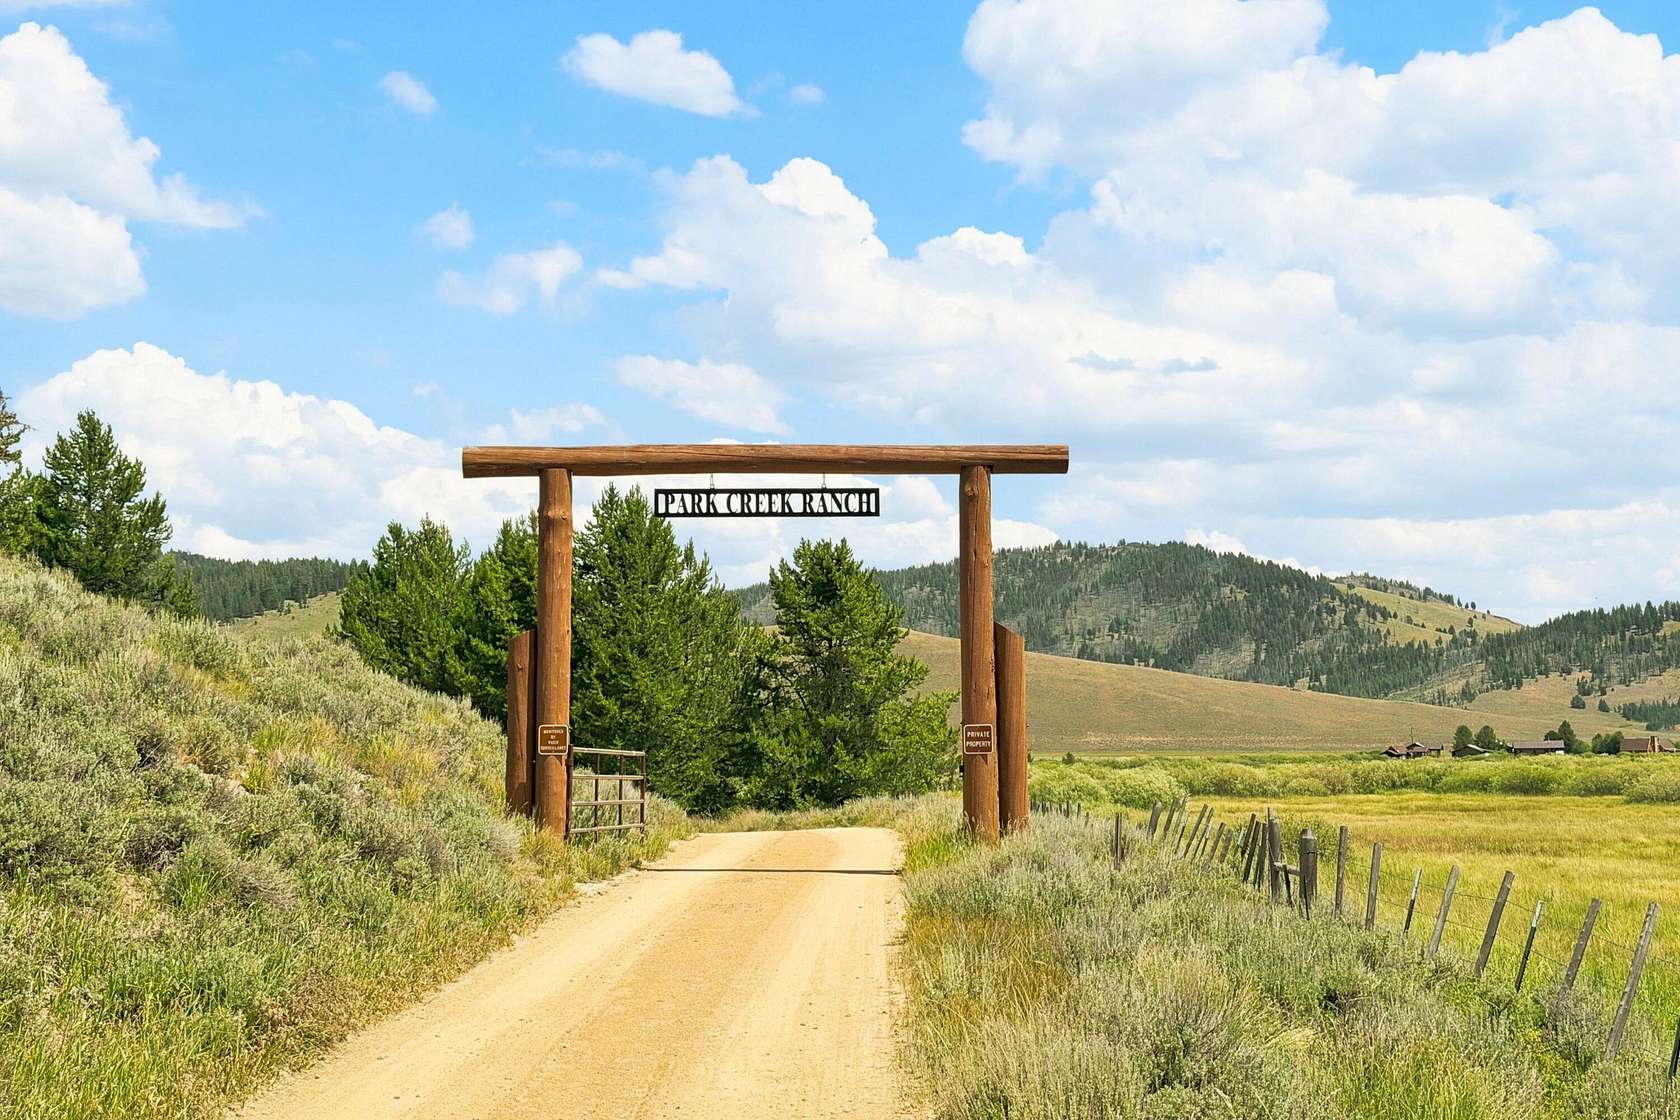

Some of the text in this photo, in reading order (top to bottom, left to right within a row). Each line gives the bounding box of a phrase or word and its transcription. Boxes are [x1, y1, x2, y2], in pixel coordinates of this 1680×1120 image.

[664, 492, 872, 514] PARK CREEK RANCH
